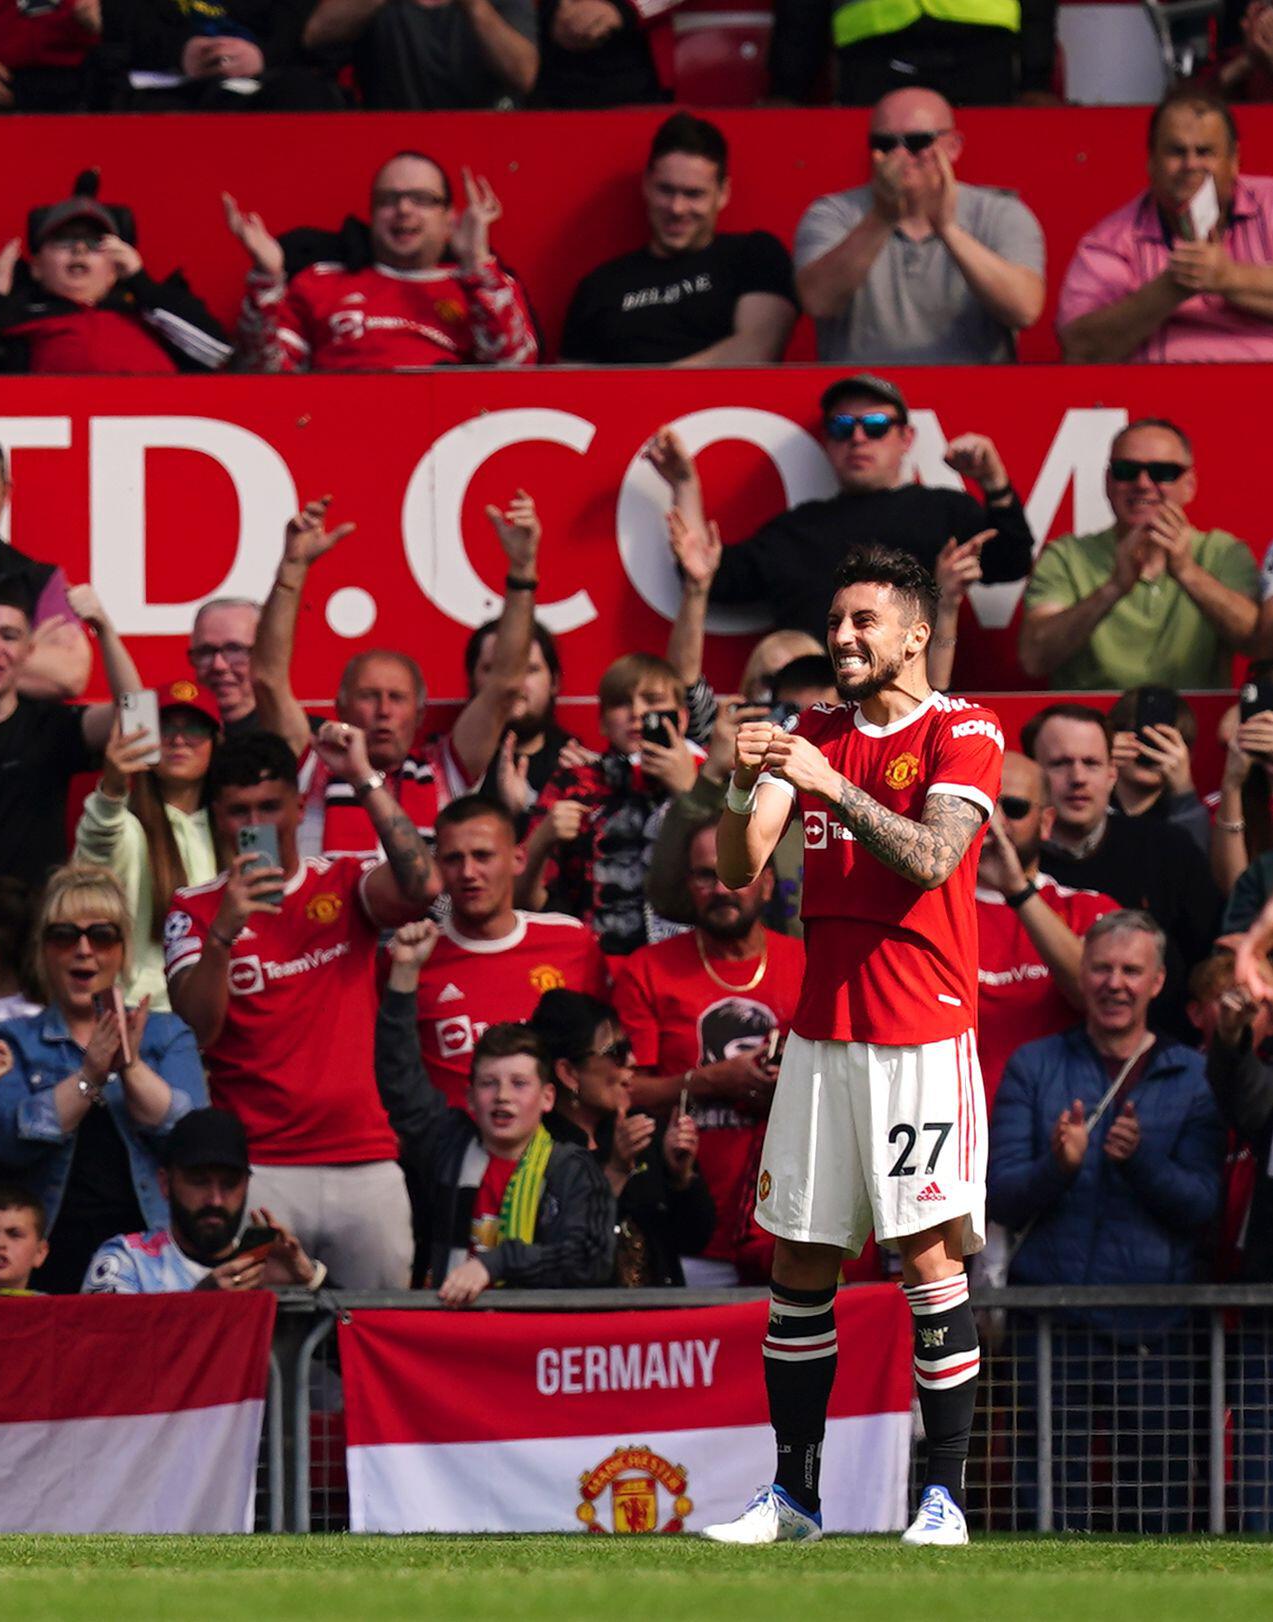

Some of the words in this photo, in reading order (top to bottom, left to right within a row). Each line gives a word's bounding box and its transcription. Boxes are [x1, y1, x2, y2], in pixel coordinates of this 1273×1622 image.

[951, 719, 1005, 755] KOHL
[262, 942, 350, 980] TeamView
[887, 1121, 955, 1177] 27
[535, 1337, 721, 1396] GERMANY
